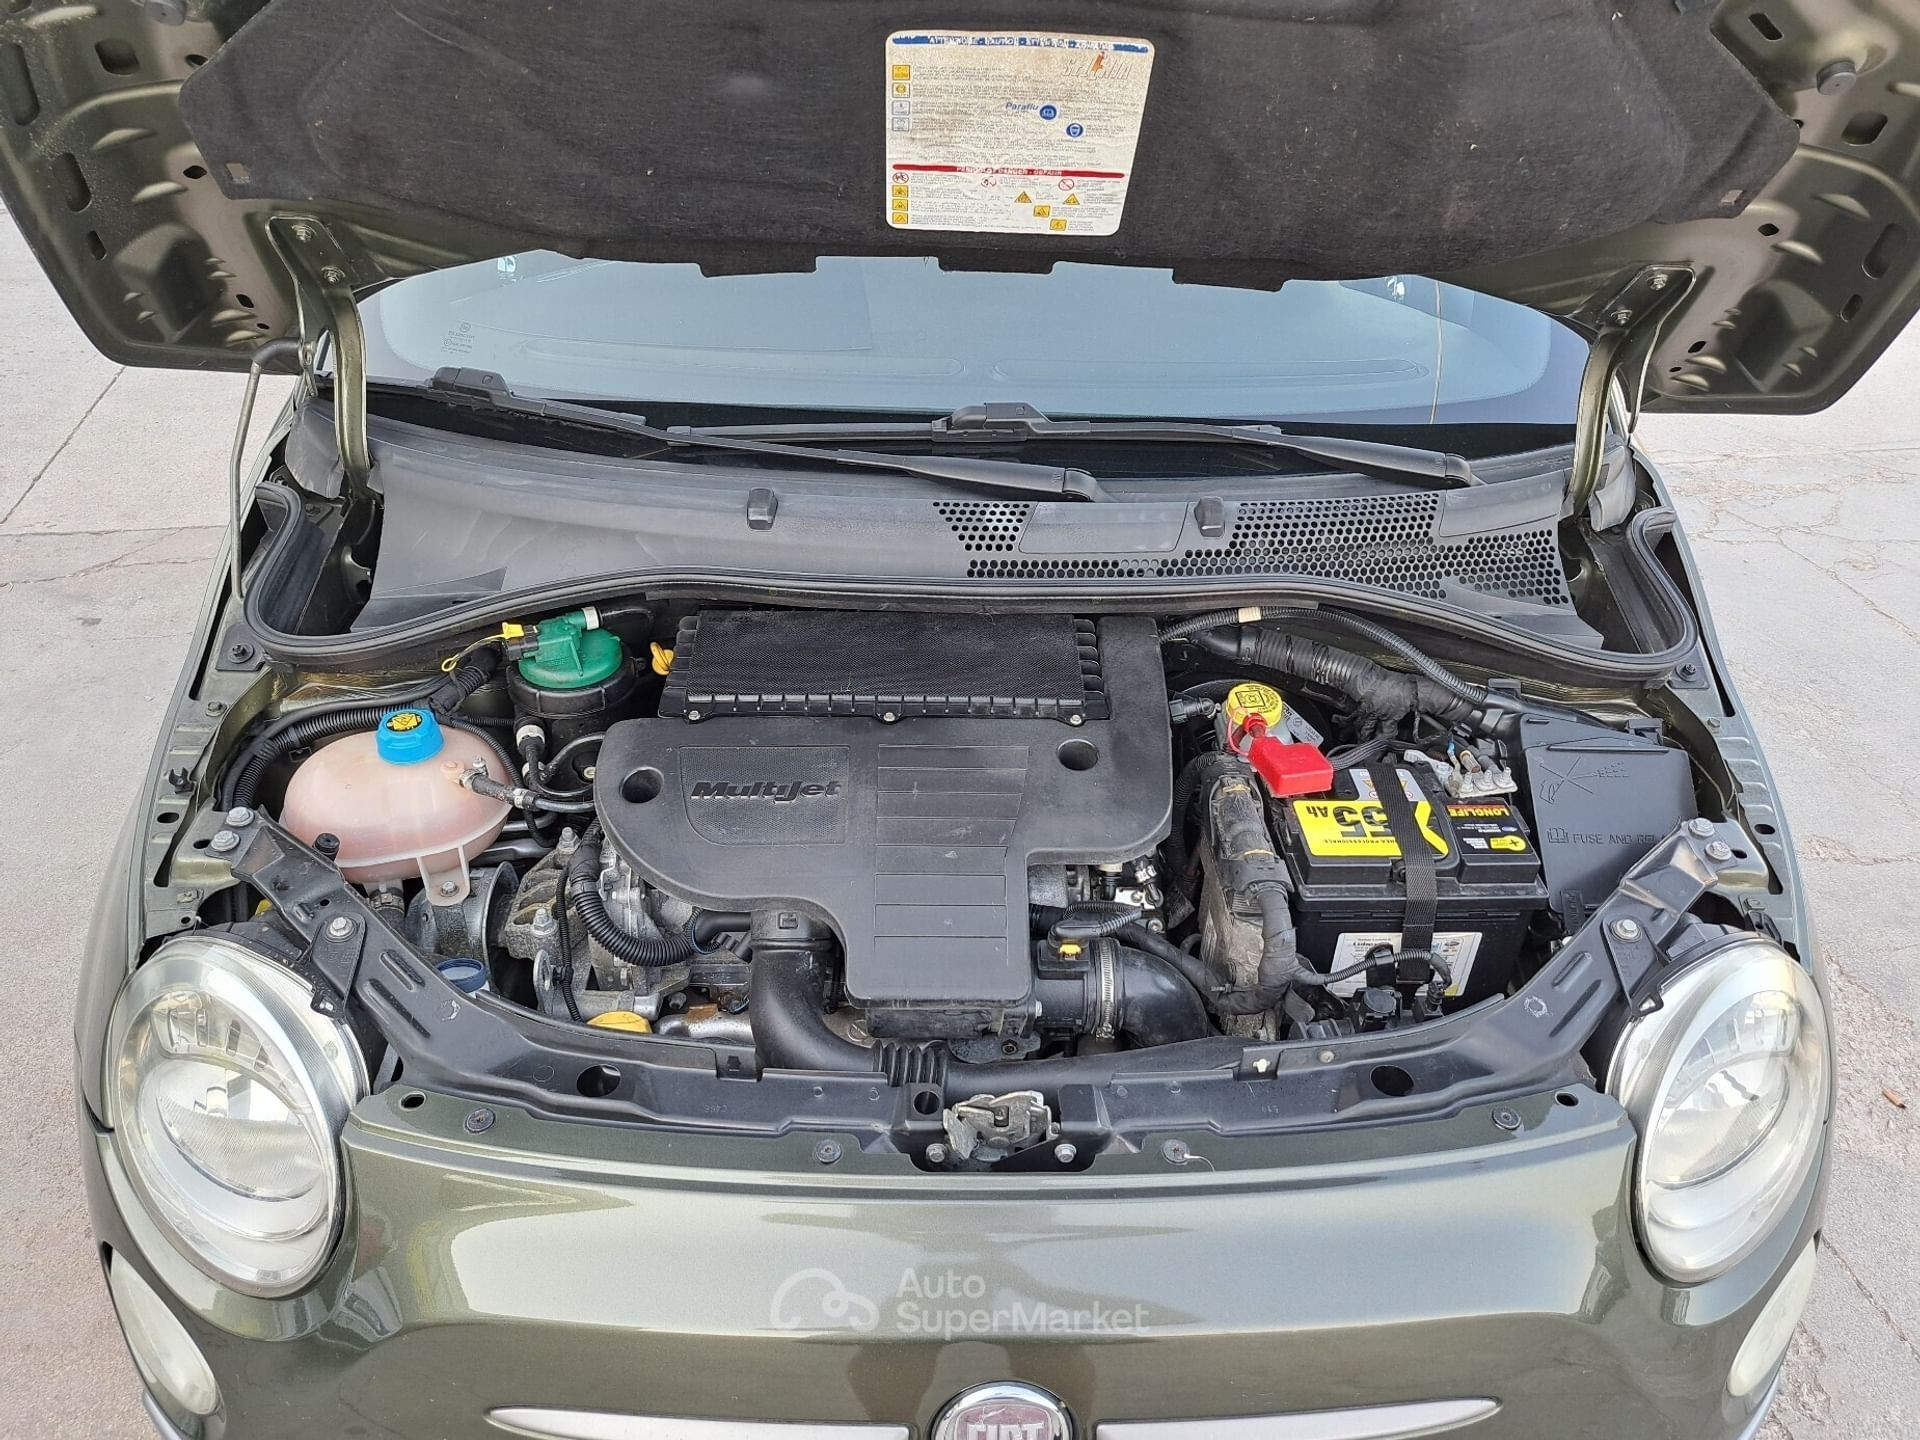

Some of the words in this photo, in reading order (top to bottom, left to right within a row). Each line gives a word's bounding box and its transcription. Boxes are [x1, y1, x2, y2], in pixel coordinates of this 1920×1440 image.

[1306, 804, 1329, 819] Ah
[1450, 804, 1510, 818] LONGLIFE
[1572, 832, 1605, 845] FUSE
[1609, 832, 1632, 845] AND
